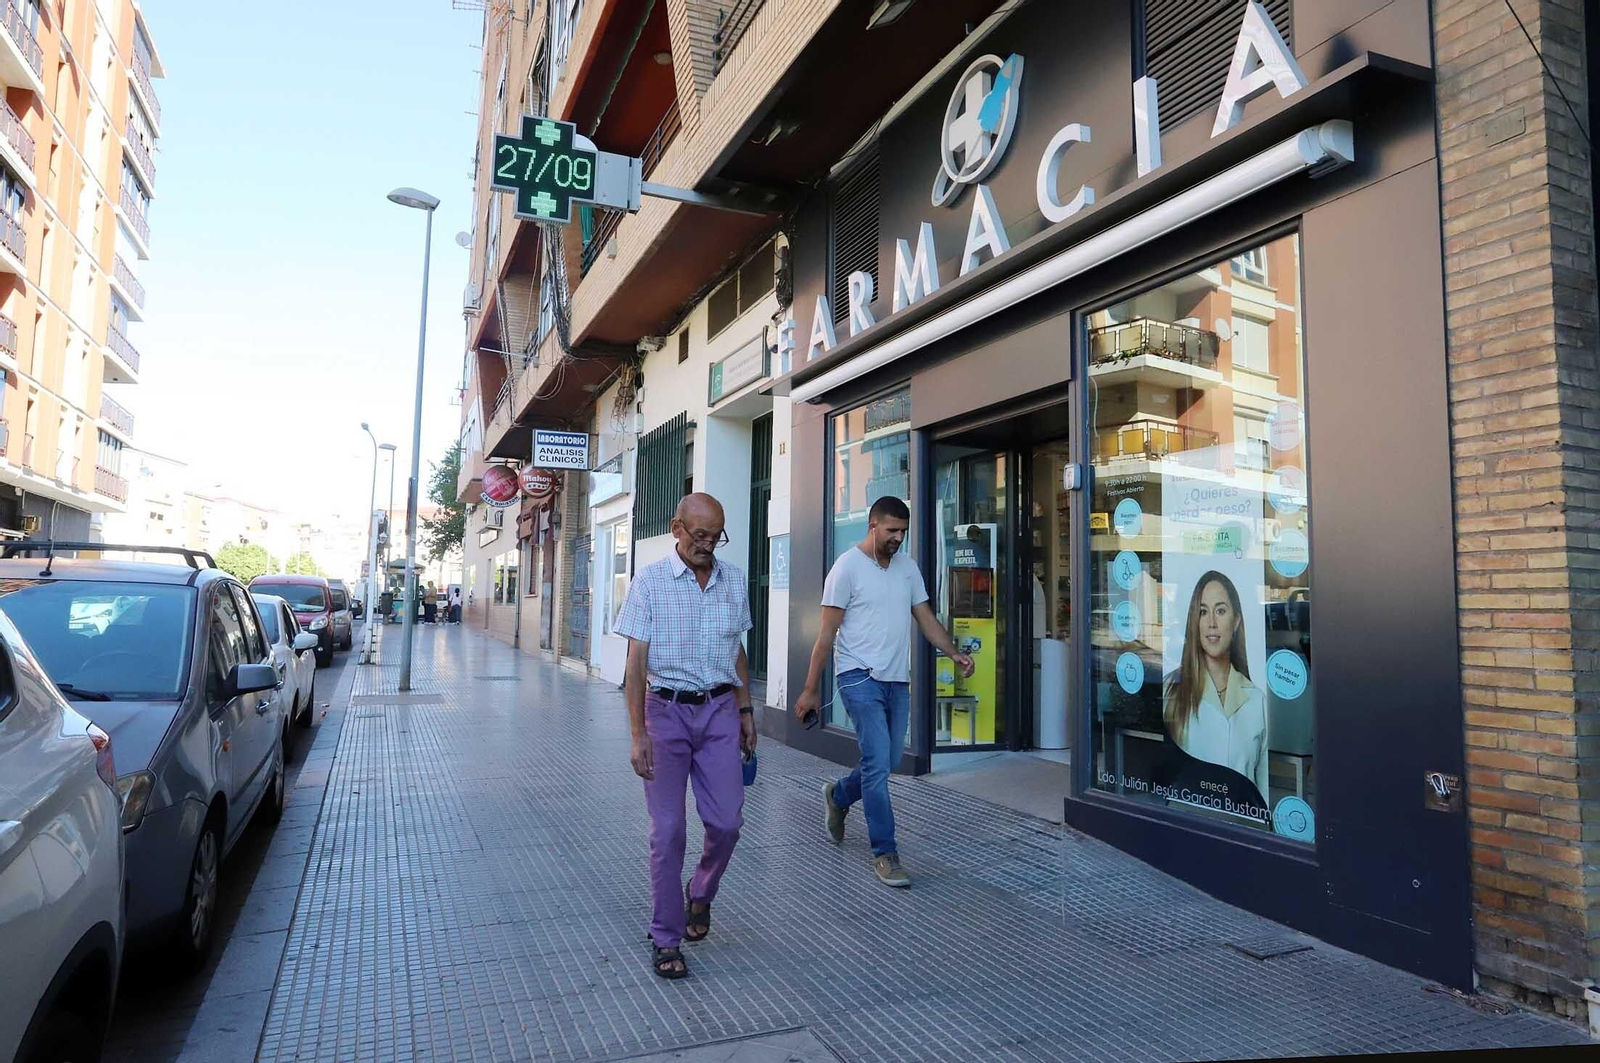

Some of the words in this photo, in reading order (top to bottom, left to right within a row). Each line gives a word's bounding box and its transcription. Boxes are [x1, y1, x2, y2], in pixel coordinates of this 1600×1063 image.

[497, 144, 592, 191] 27/09
[778, 0, 1308, 379] FARMACIA
[538, 434, 586, 445] LABORATORIO
[539, 447, 584, 457] ANALISIS
[539, 456, 585, 464] CLINICOS
[523, 474, 552, 483] Mahou
[1107, 489, 1126, 497] Festivos
[1126, 486, 1145, 494] Abierto
[1184, 487, 1239, 505] ¿Quieres
[1215, 499, 1251, 517] peso?
[1274, 662, 1284, 671] Sin
[1283, 668, 1300, 679] pasar
[1274, 671, 1297, 686] hambre
[1120, 774, 1149, 792] Julián
[1150, 781, 1179, 799] Jesús
[1180, 788, 1222, 809] García
[1224, 797, 1272, 820] Bustam
